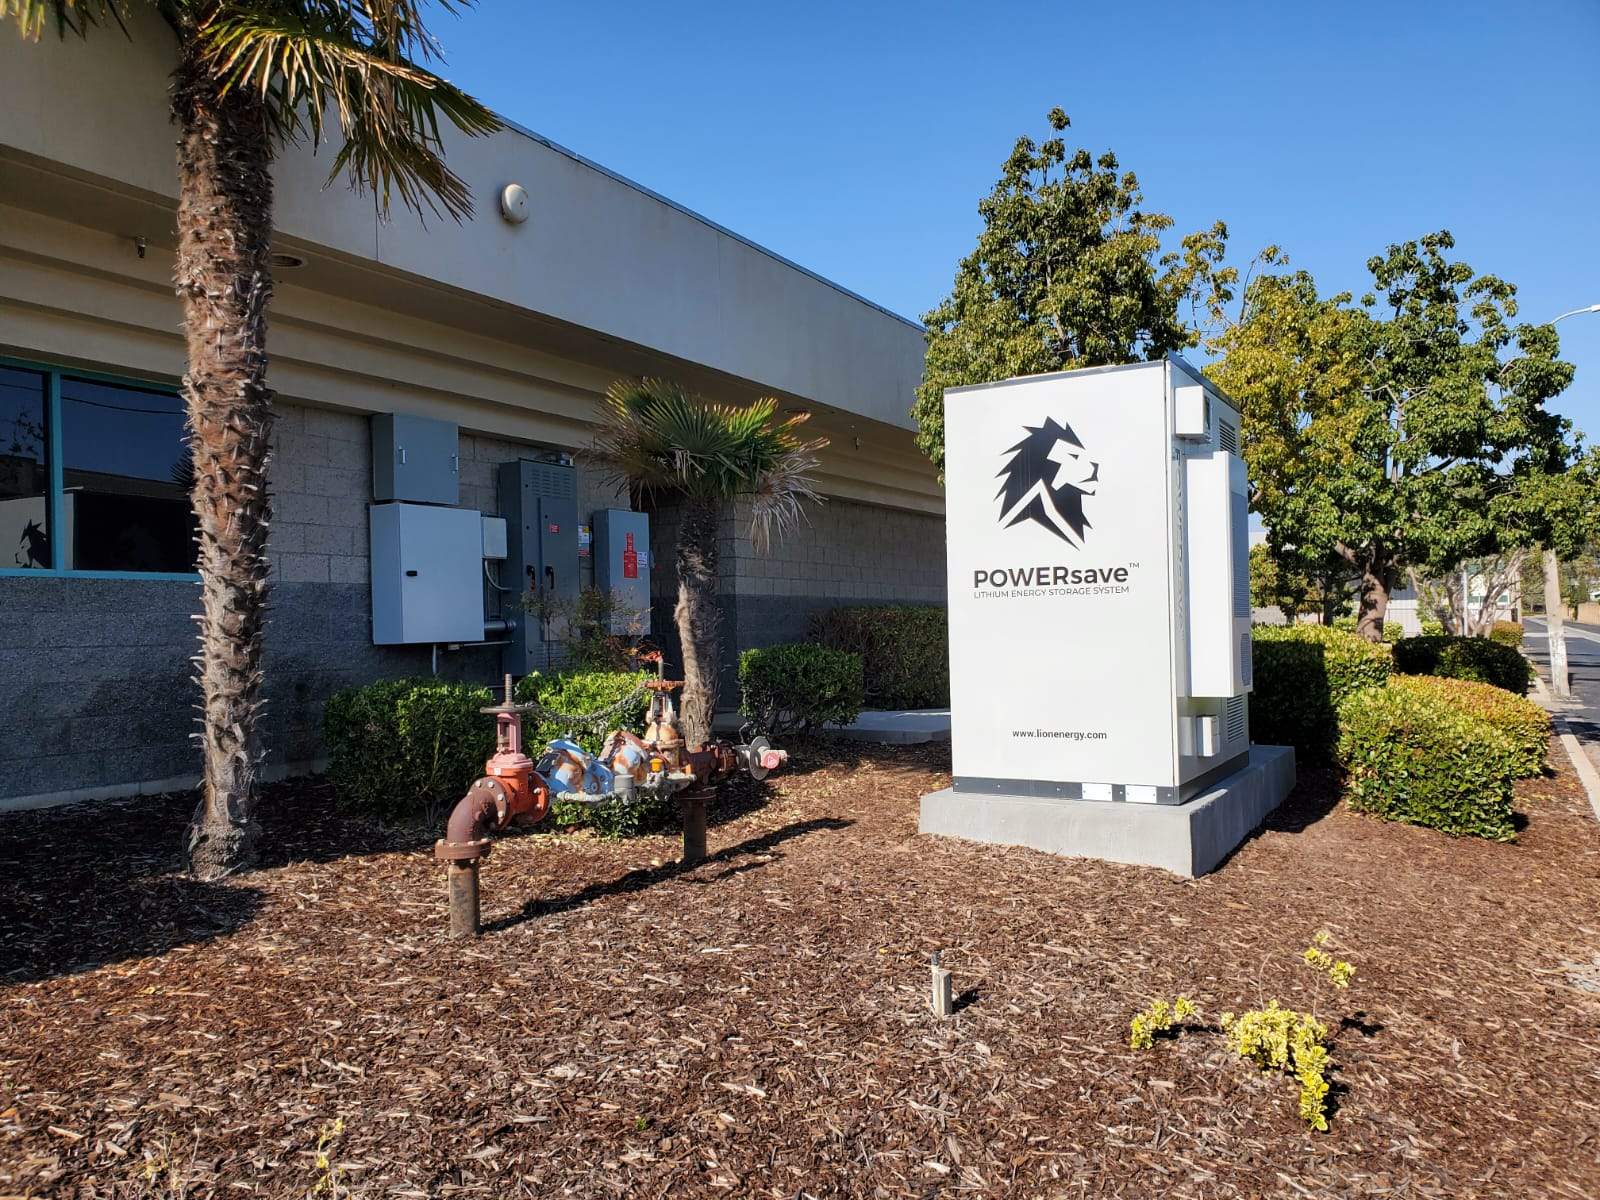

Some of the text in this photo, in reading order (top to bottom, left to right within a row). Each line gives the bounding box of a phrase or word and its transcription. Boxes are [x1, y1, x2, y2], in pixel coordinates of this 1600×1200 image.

[974, 566, 1129, 588] POWERsave
[974, 586, 1130, 599] LITHIUM ENERGY STORAGE SYSTEM
[1012, 729, 1107, 741] www.lionenergy.com
